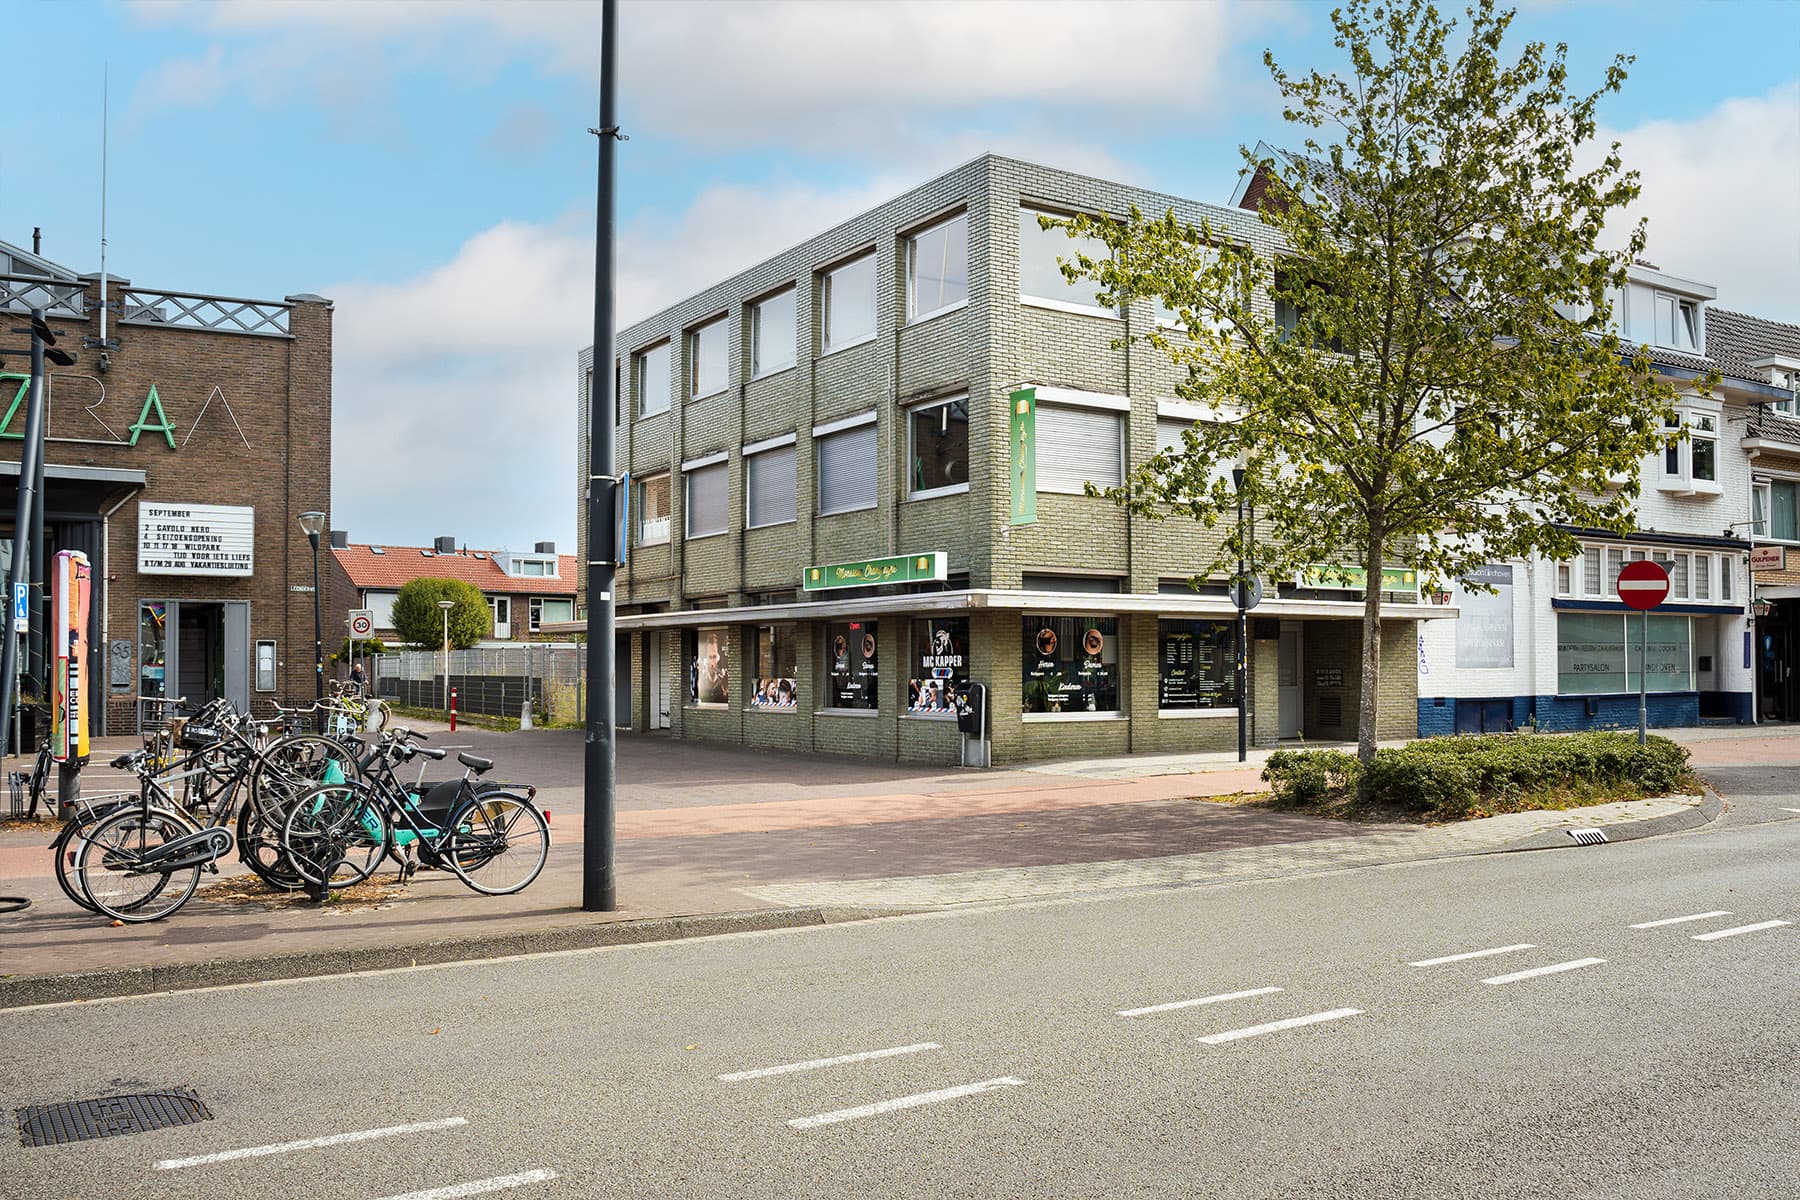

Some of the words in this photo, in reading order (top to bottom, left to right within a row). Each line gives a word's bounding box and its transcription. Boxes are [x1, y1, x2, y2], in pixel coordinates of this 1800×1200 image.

[149, 509, 190, 518] SEPTEMBER
[157, 524, 185, 533] CAVOLO
[191, 526, 210, 534] NERO
[156, 533, 223, 543] SEIZOENSOPENING
[154, 542, 159, 550] 11
[185, 543, 221, 551] WILDPARK
[173, 551, 187, 559] TIJD
[192, 552, 210, 560] VOOR
[213, 553, 228, 561] IETS
[231, 553, 250, 561] LIEFS
[190, 561, 249, 570] VAKANTIESLUITING
[17, 585, 26, 604] P
[356, 621, 367, 629] 30
[923, 655, 934, 667] MC
[935, 655, 962, 667] KAPPER
[1573, 663, 1610, 672] PARTYSALON
[1646, 663, 1676, 671] INDHOVEN
